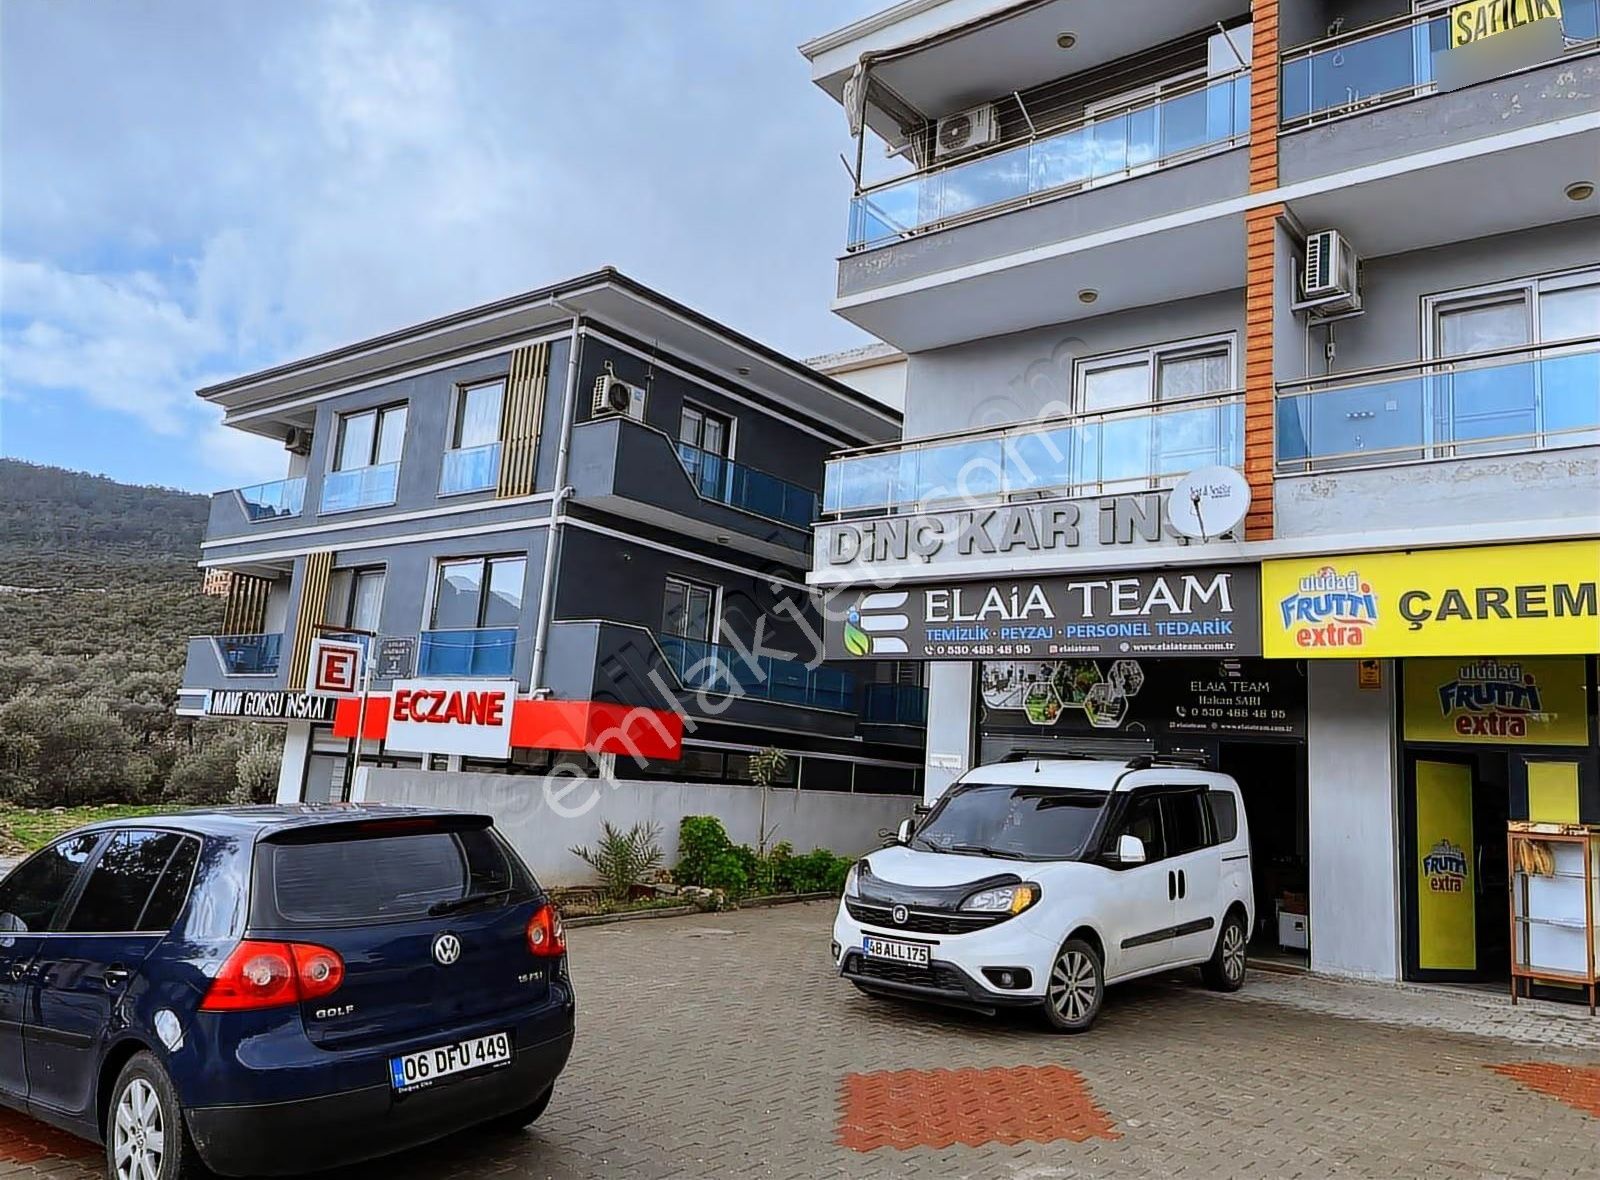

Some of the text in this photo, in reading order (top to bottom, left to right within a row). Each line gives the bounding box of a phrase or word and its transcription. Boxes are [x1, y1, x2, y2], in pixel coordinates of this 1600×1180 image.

[957, 501, 1080, 555] KAR
[1066, 573, 1235, 619] TEAM
[1398, 582, 1598, 631] ÇAREM
[925, 617, 1233, 641] TEMİZLİK PEYZAJ PERSONEL TEDARİK
[1296, 622, 1363, 648] extra
[936, 645, 945, 654] 0
[947, 645, 969, 654] 530
[1132, 641, 1236, 652] www.elaiateam.com.tr
[325, 655, 348, 685] E
[1229, 681, 1270, 693] TEAM
[393, 688, 506, 726] ECZANE
[1191, 708, 1199, 716] 0
[1455, 711, 1527, 737] extra
[1430, 876, 1462, 892] extra
[869, 940, 927, 962] 48 ALL 175
[315, 1004, 355, 1019] GOLF
[404, 1034, 508, 1081] 06 DFU 449
